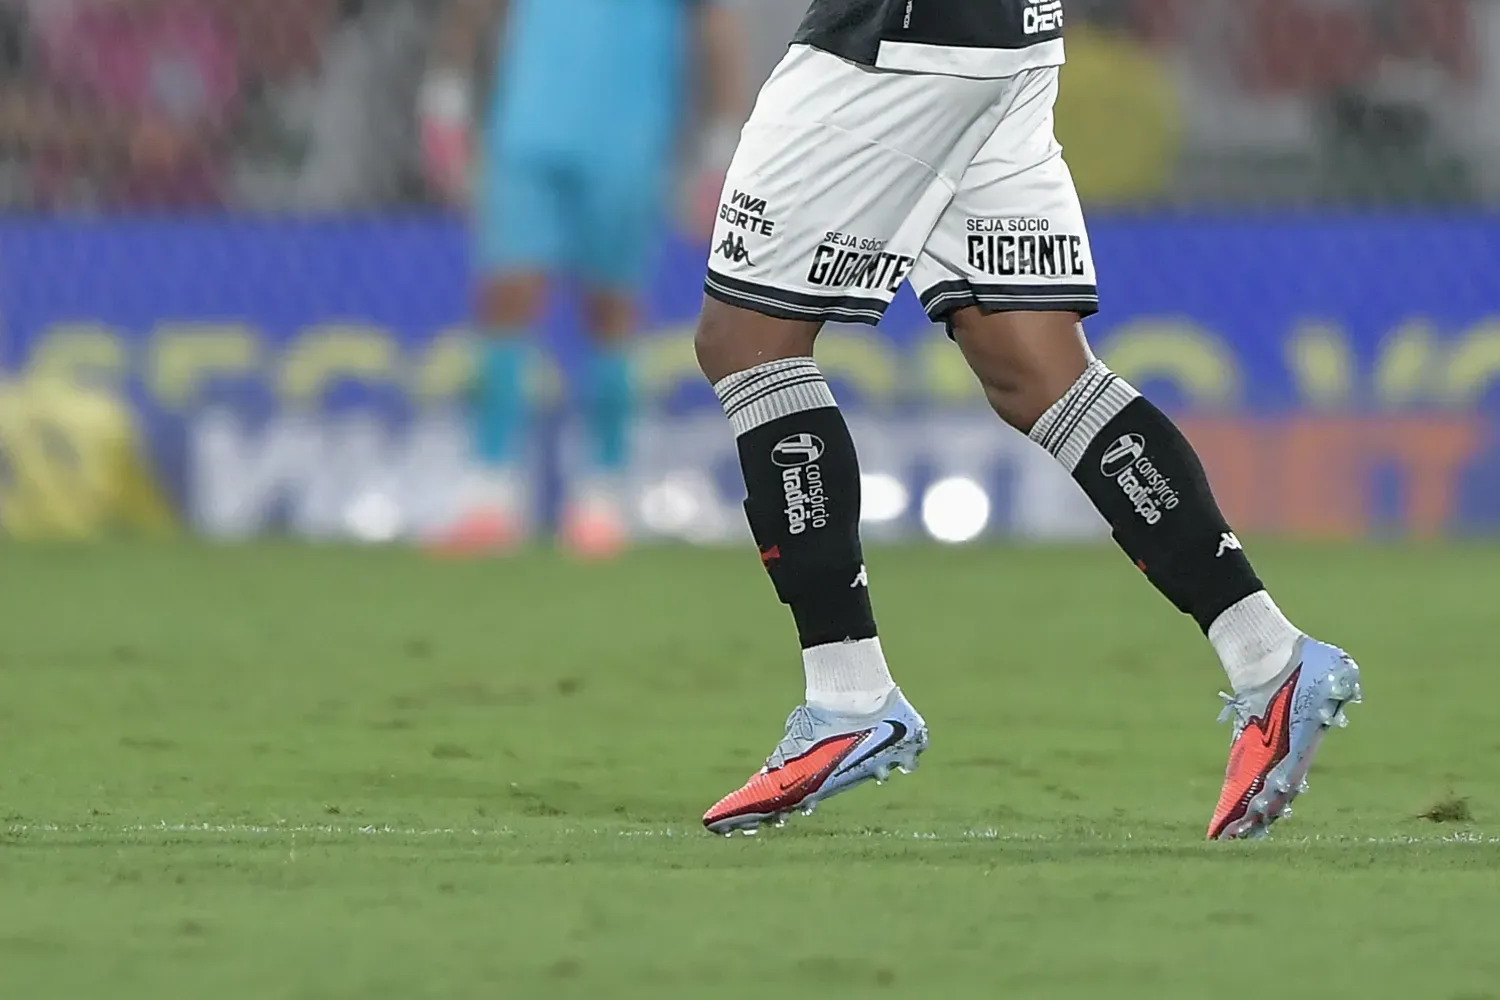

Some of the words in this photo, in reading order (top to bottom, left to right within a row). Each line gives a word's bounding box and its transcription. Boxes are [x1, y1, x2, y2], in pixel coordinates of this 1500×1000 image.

[719, 203, 775, 237] SORTE
[731, 188, 768, 216] VIVA
[966, 218, 1005, 232] SEJA
[1008, 215, 1050, 232] SÓCIO
[824, 231, 857, 249] SEJA
[859, 236, 889, 252] SÓC
[966, 234, 1084, 276] GIGANTE
[806, 244, 916, 294] GIGANTE
[782, 466, 811, 534] tradição
[805, 464, 830, 528] consórcio
[1117, 466, 1162, 525] tradição
[1135, 457, 1179, 510] consórcio
